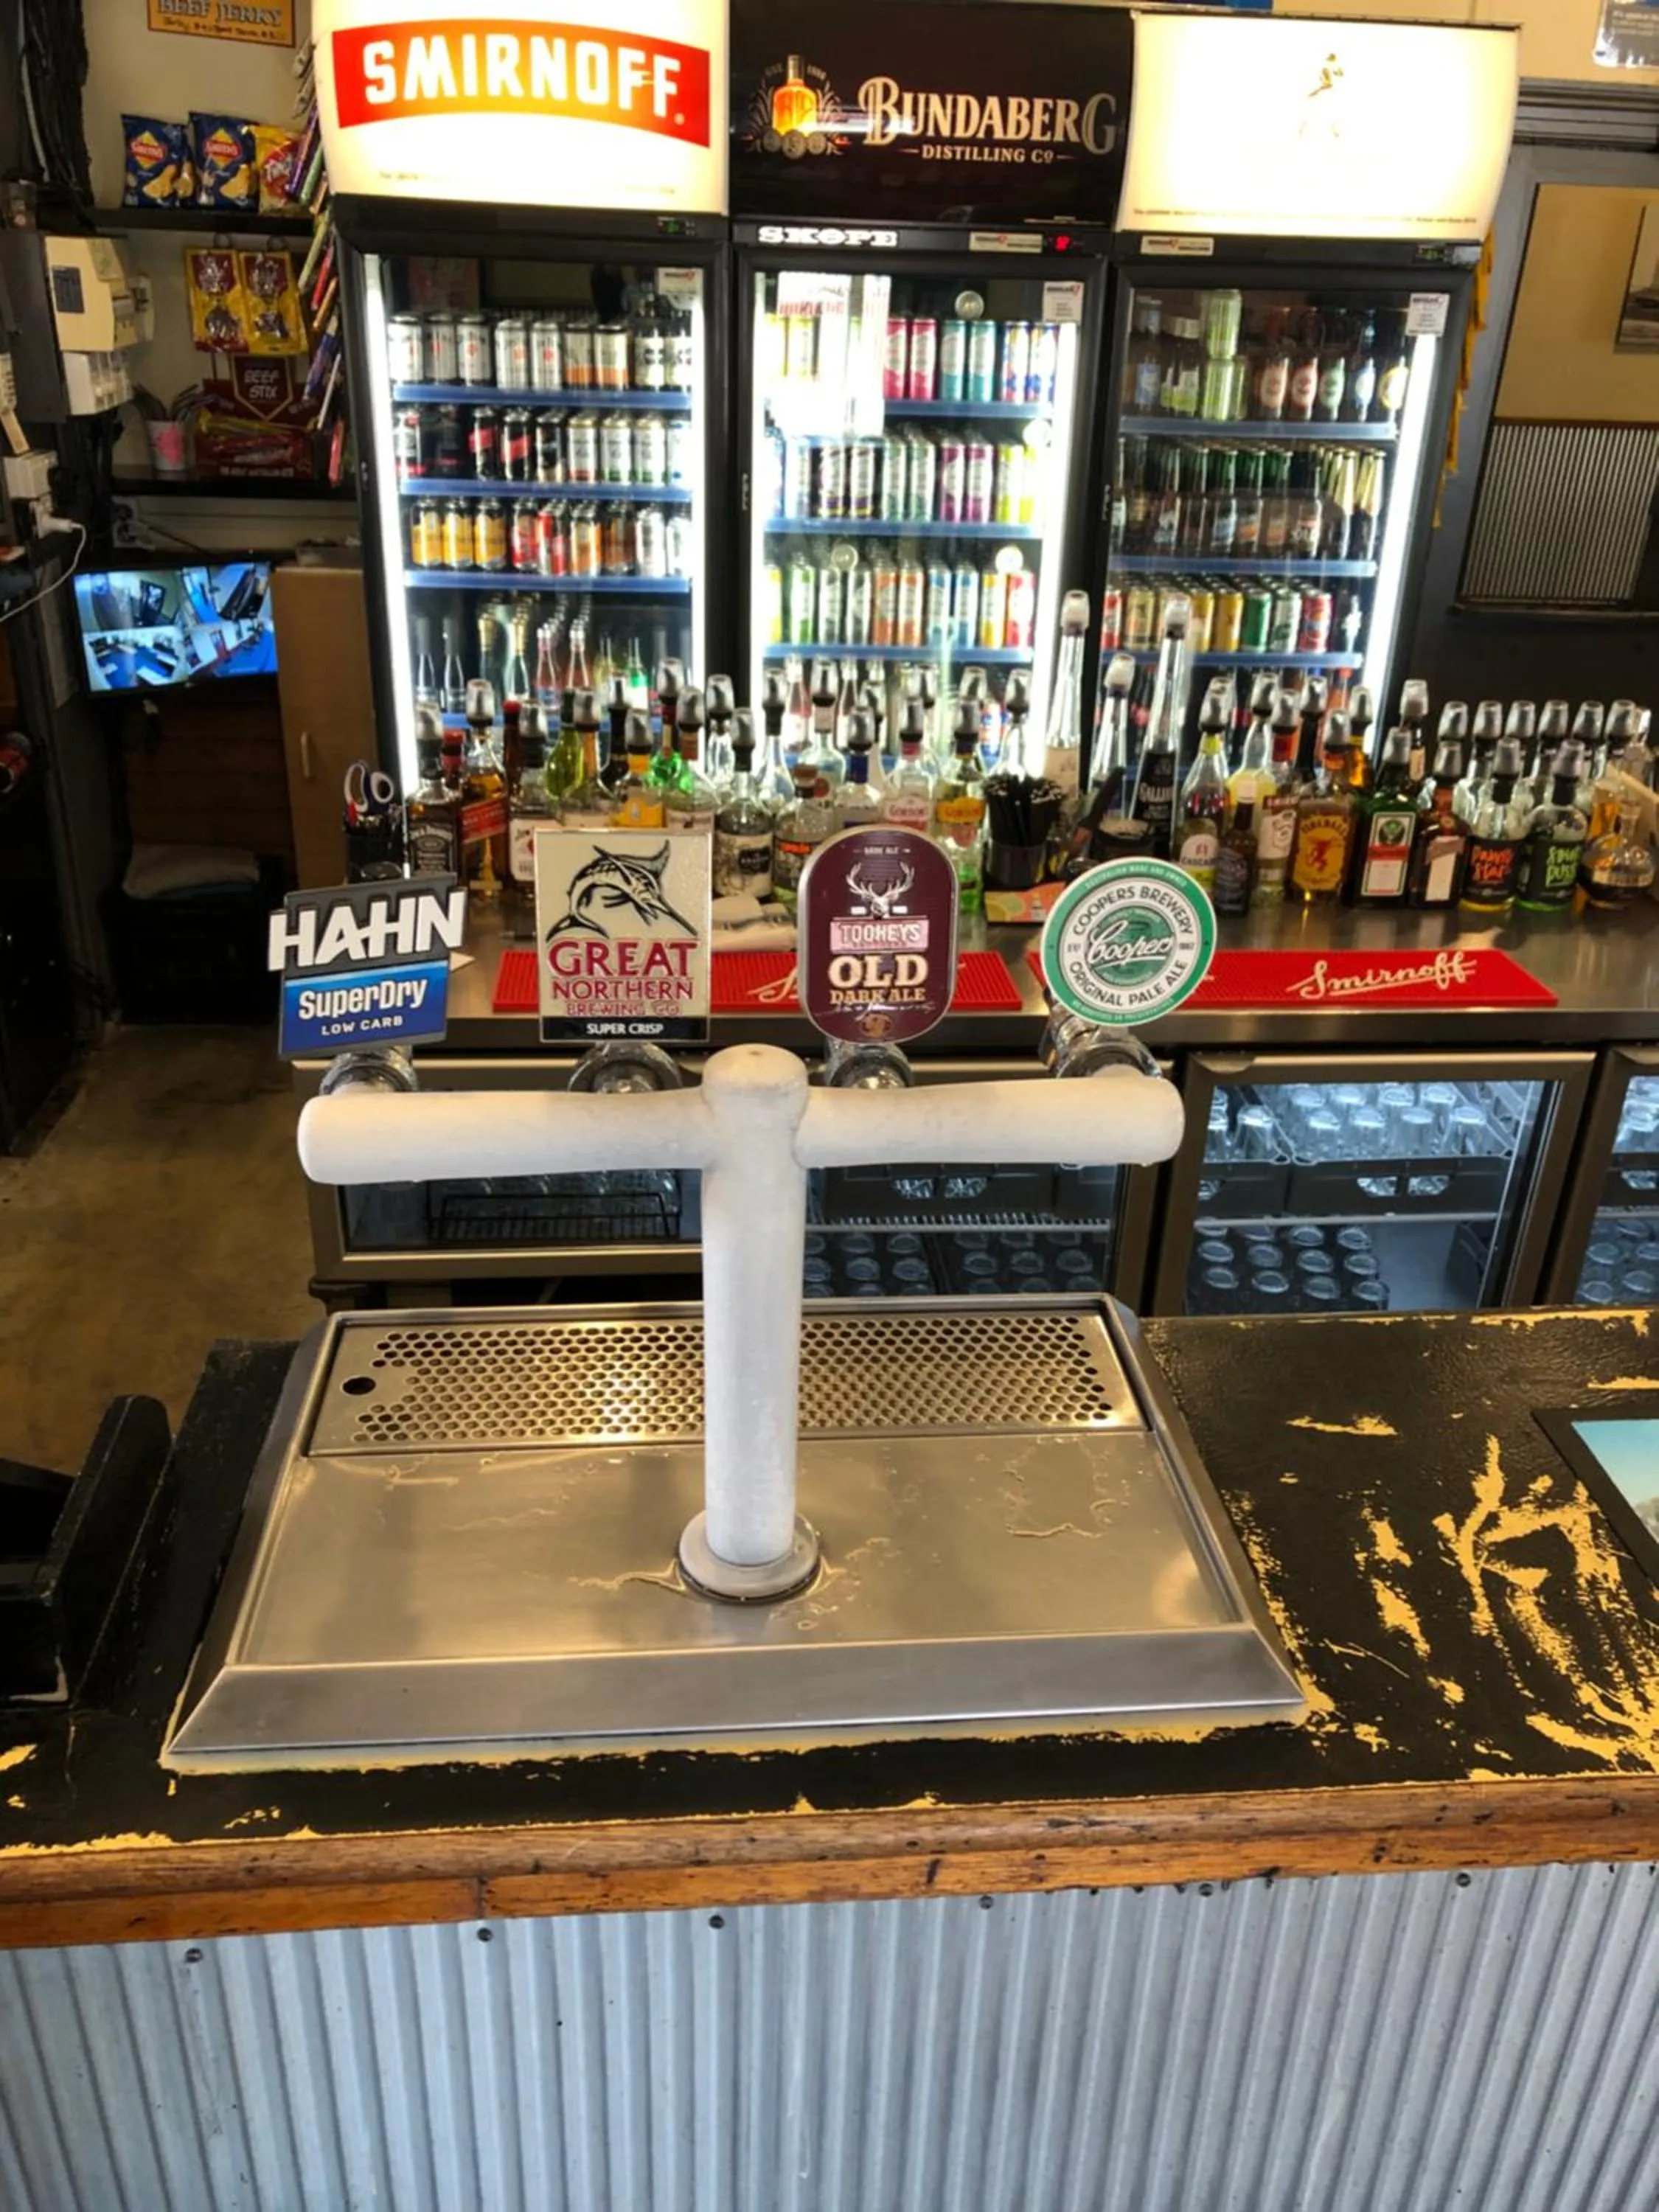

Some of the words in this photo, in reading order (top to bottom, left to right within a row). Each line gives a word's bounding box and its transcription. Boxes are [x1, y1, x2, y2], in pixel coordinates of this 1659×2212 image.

[363, 34, 681, 117] SMIRNOFF
[858, 76, 1119, 156] BUNDABERG
[922, 144, 1026, 164] DISTILLING
[757, 226, 898, 248] SKOPE
[1072, 886, 1136, 936] COOPERS
[1139, 885, 1194, 936] BREWERY
[268, 890, 467, 972] HAHN
[840, 924, 922, 943] TOOHEYS
[1088, 919, 1175, 966] Coopers
[548, 940, 699, 977] GREAT
[828, 954, 928, 989] OLD
[1286, 951, 1478, 999] Smirnoff
[298, 978, 428, 1020] SuperDry
[552, 980, 694, 1001] NORTHERN
[829, 990, 886, 1005] DARK
[889, 987, 926, 1002] ALE
[1070, 961, 1123, 1007] ORIGINAL
[1127, 984, 1165, 1006] PALE
[1166, 960, 1188, 988] ALE
[321, 1021, 355, 1037] LOW
[360, 1015, 404, 1032] CARB
[566, 1003, 646, 1017] BREWING
[586, 1023, 626, 1034] SUPER
[628, 1023, 664, 1035] CRISP
